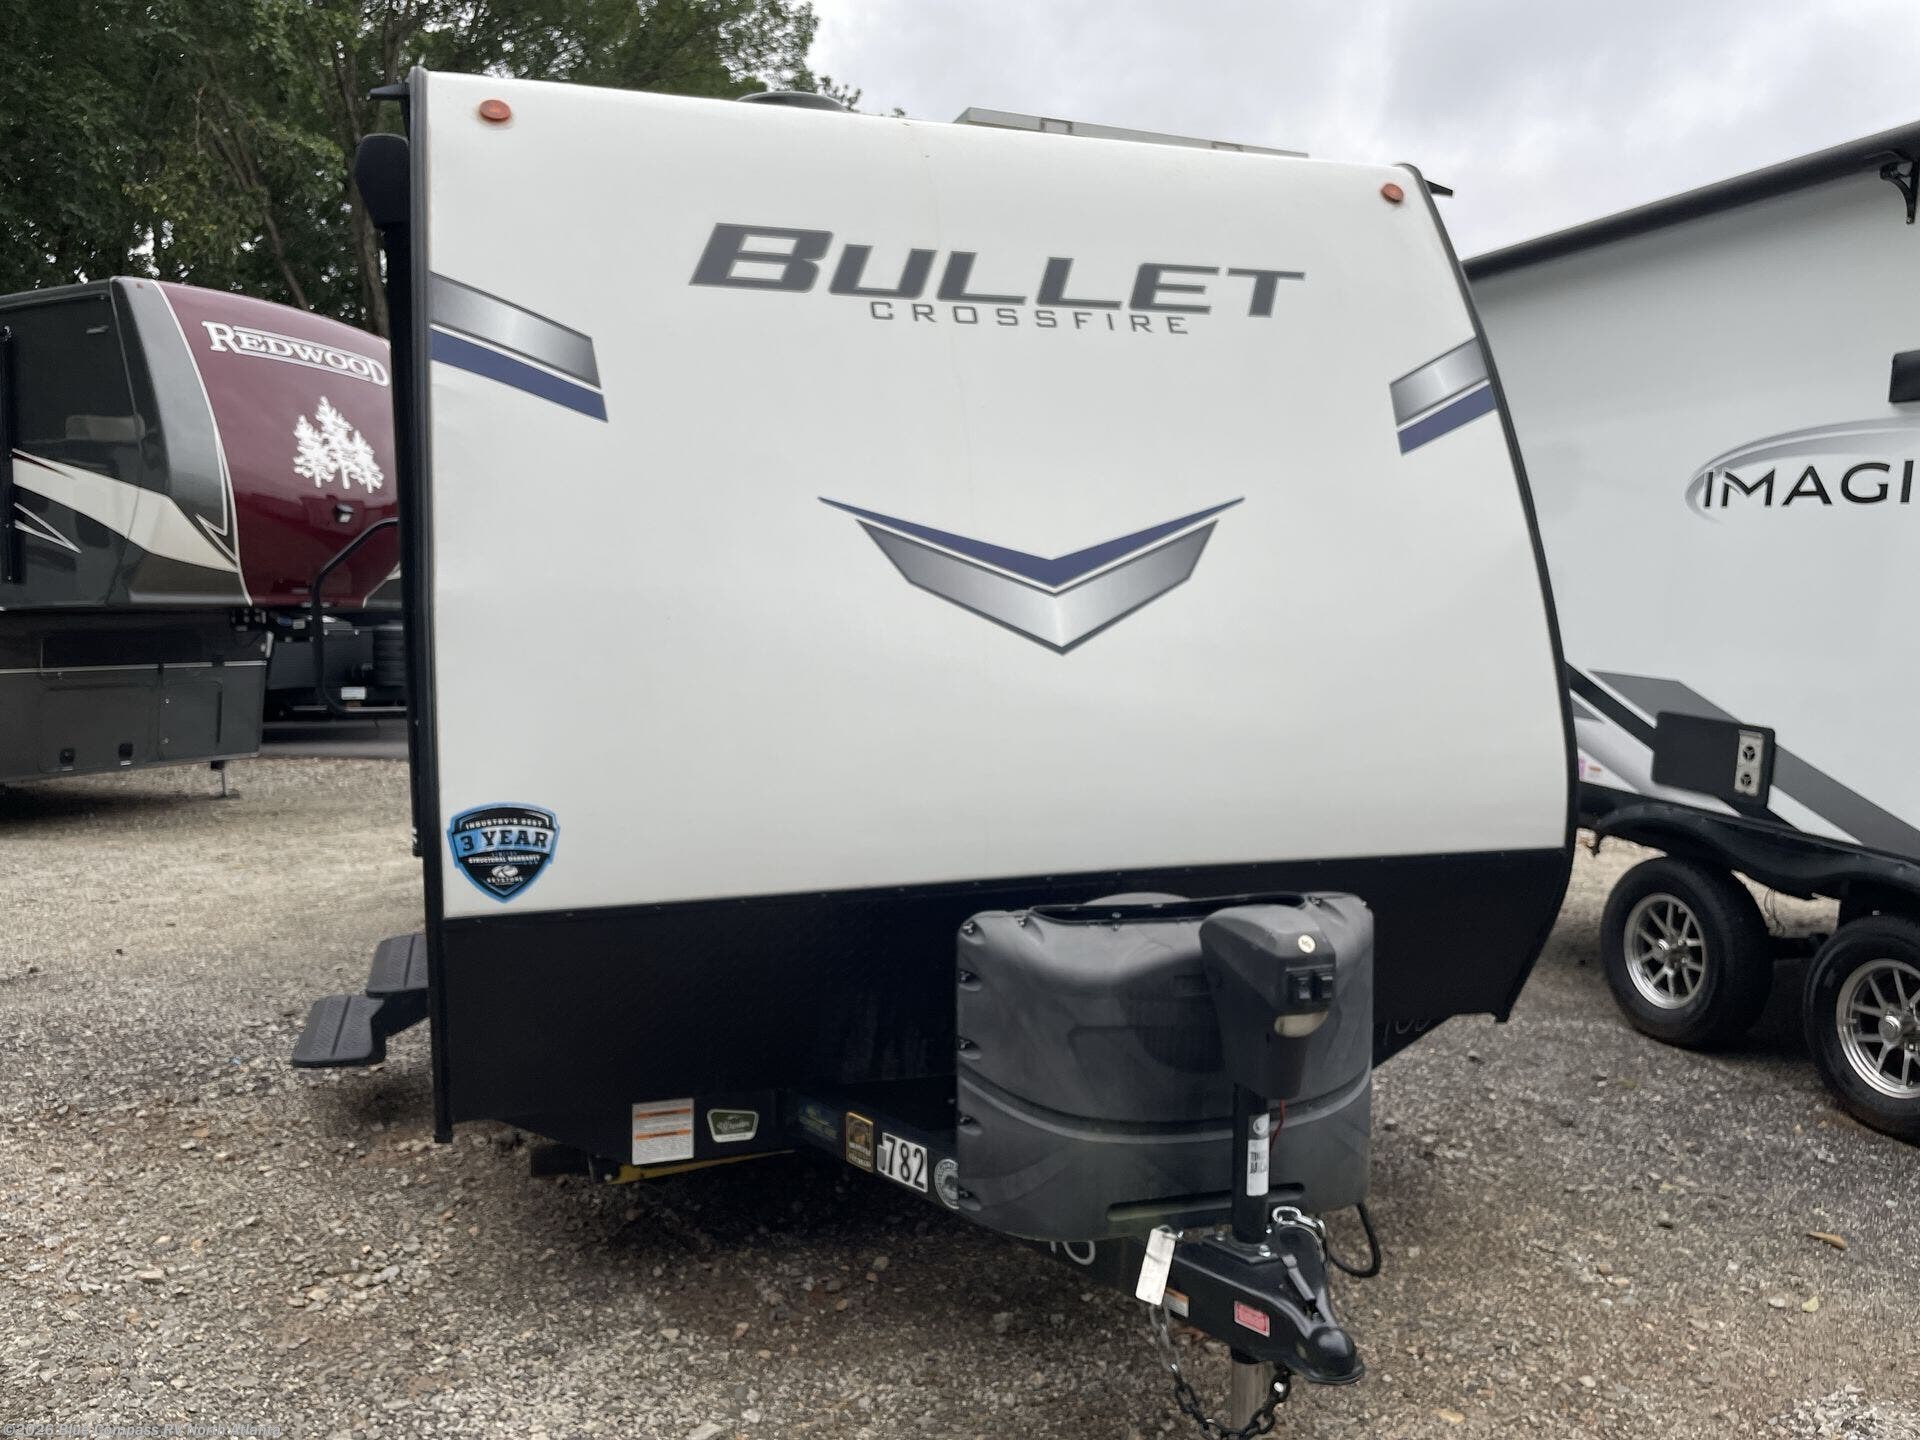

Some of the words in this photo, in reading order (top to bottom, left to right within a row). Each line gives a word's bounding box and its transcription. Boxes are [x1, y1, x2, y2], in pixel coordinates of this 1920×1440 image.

[688, 222, 1305, 319] BULLET
[869, 301, 1189, 335] CROSSFIRE
[201, 320, 390, 387] REDWOOD
[1703, 459, 1914, 508] IMAGI
[460, 835, 475, 851] 3
[481, 830, 548, 848] YEAR
[885, 1136, 925, 1189] 782
